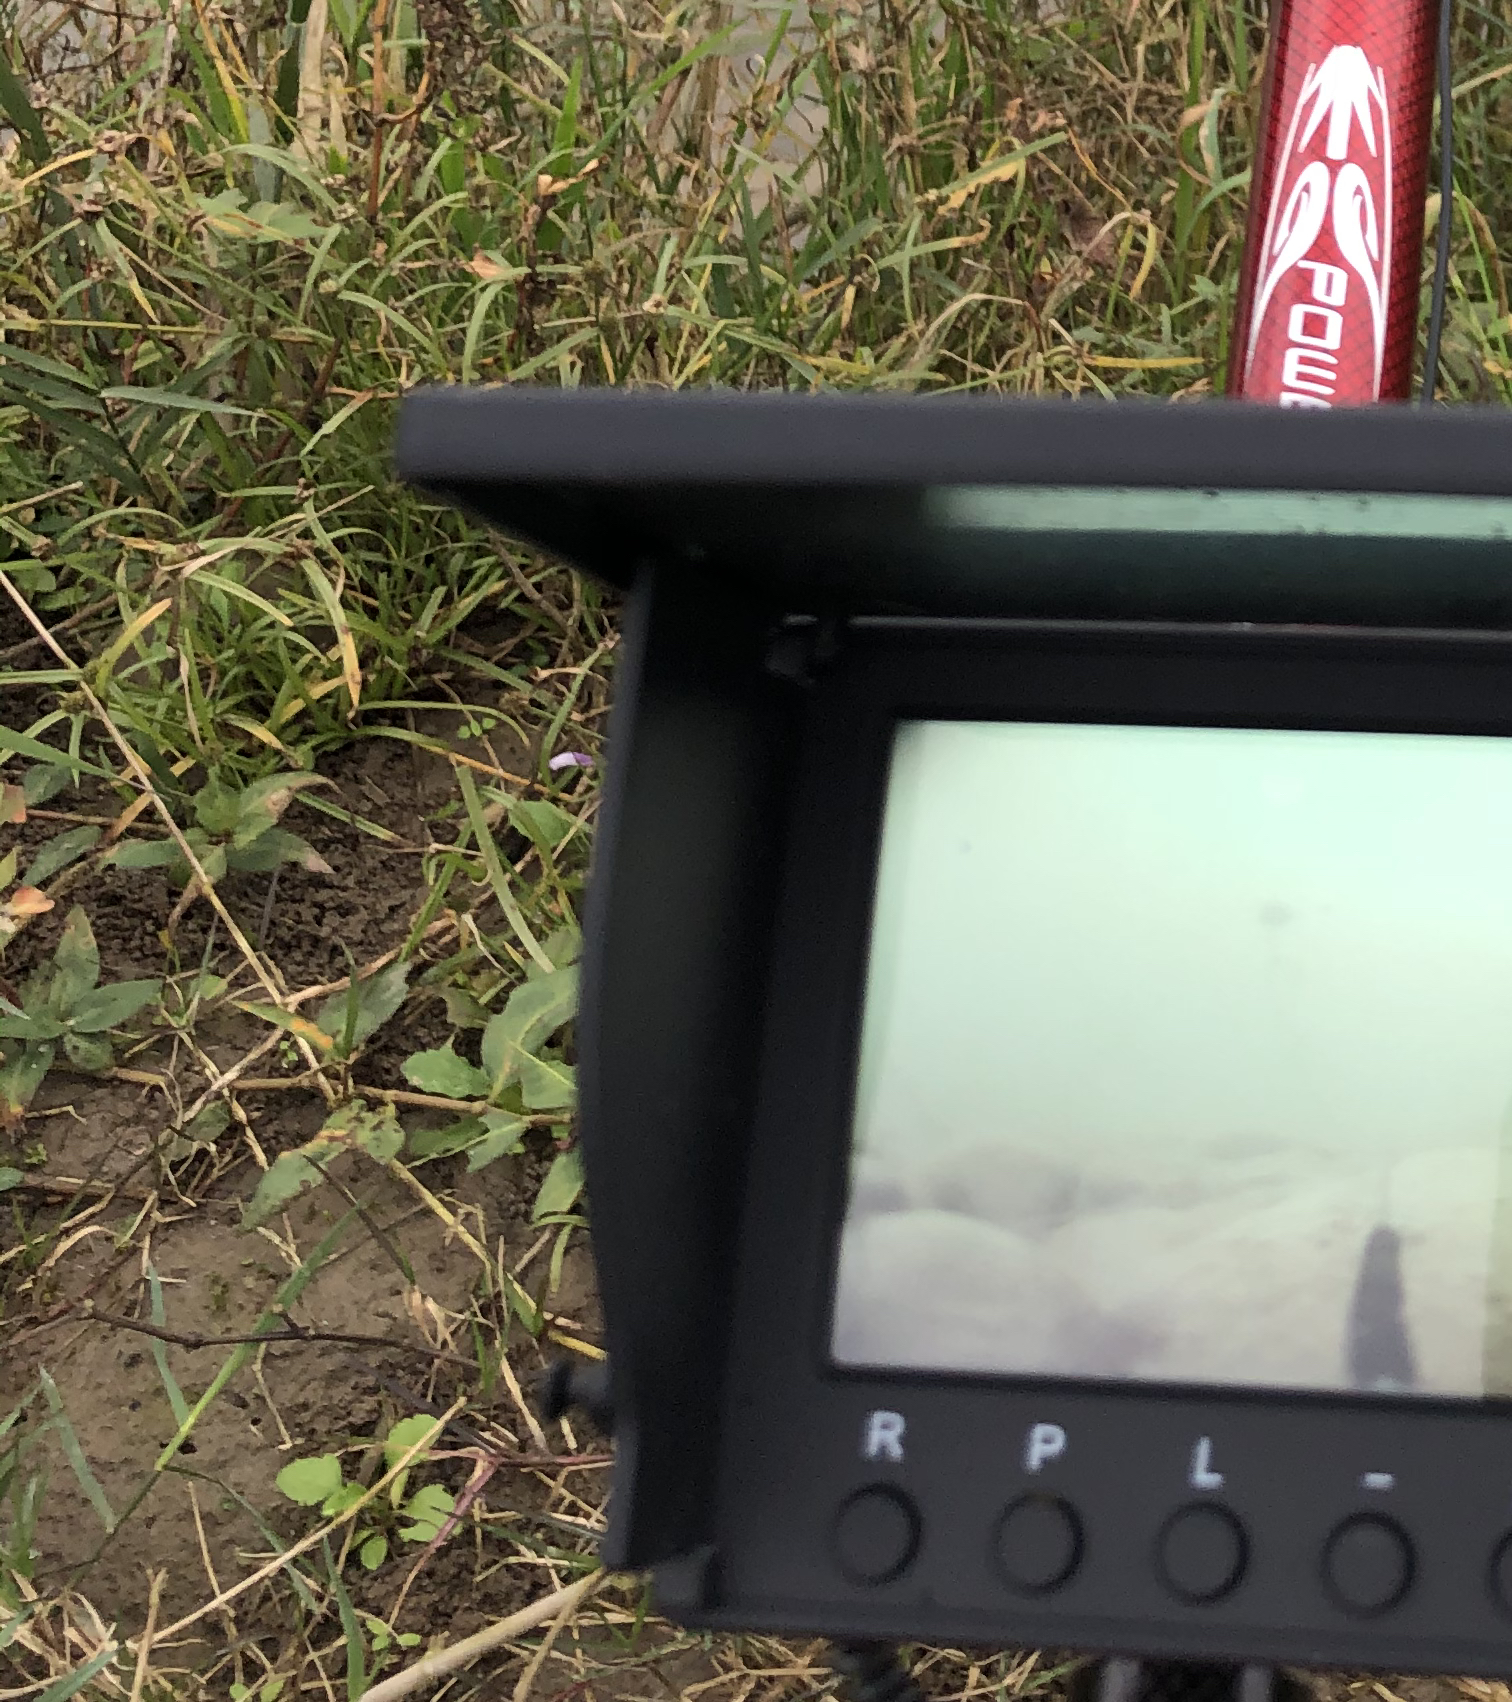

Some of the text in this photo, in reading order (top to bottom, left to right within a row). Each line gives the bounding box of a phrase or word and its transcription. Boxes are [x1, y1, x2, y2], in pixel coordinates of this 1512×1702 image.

[865, 1409, 906, 1462] R
[1025, 1422, 1067, 1474] P
[1191, 1436, 1225, 1490] L
